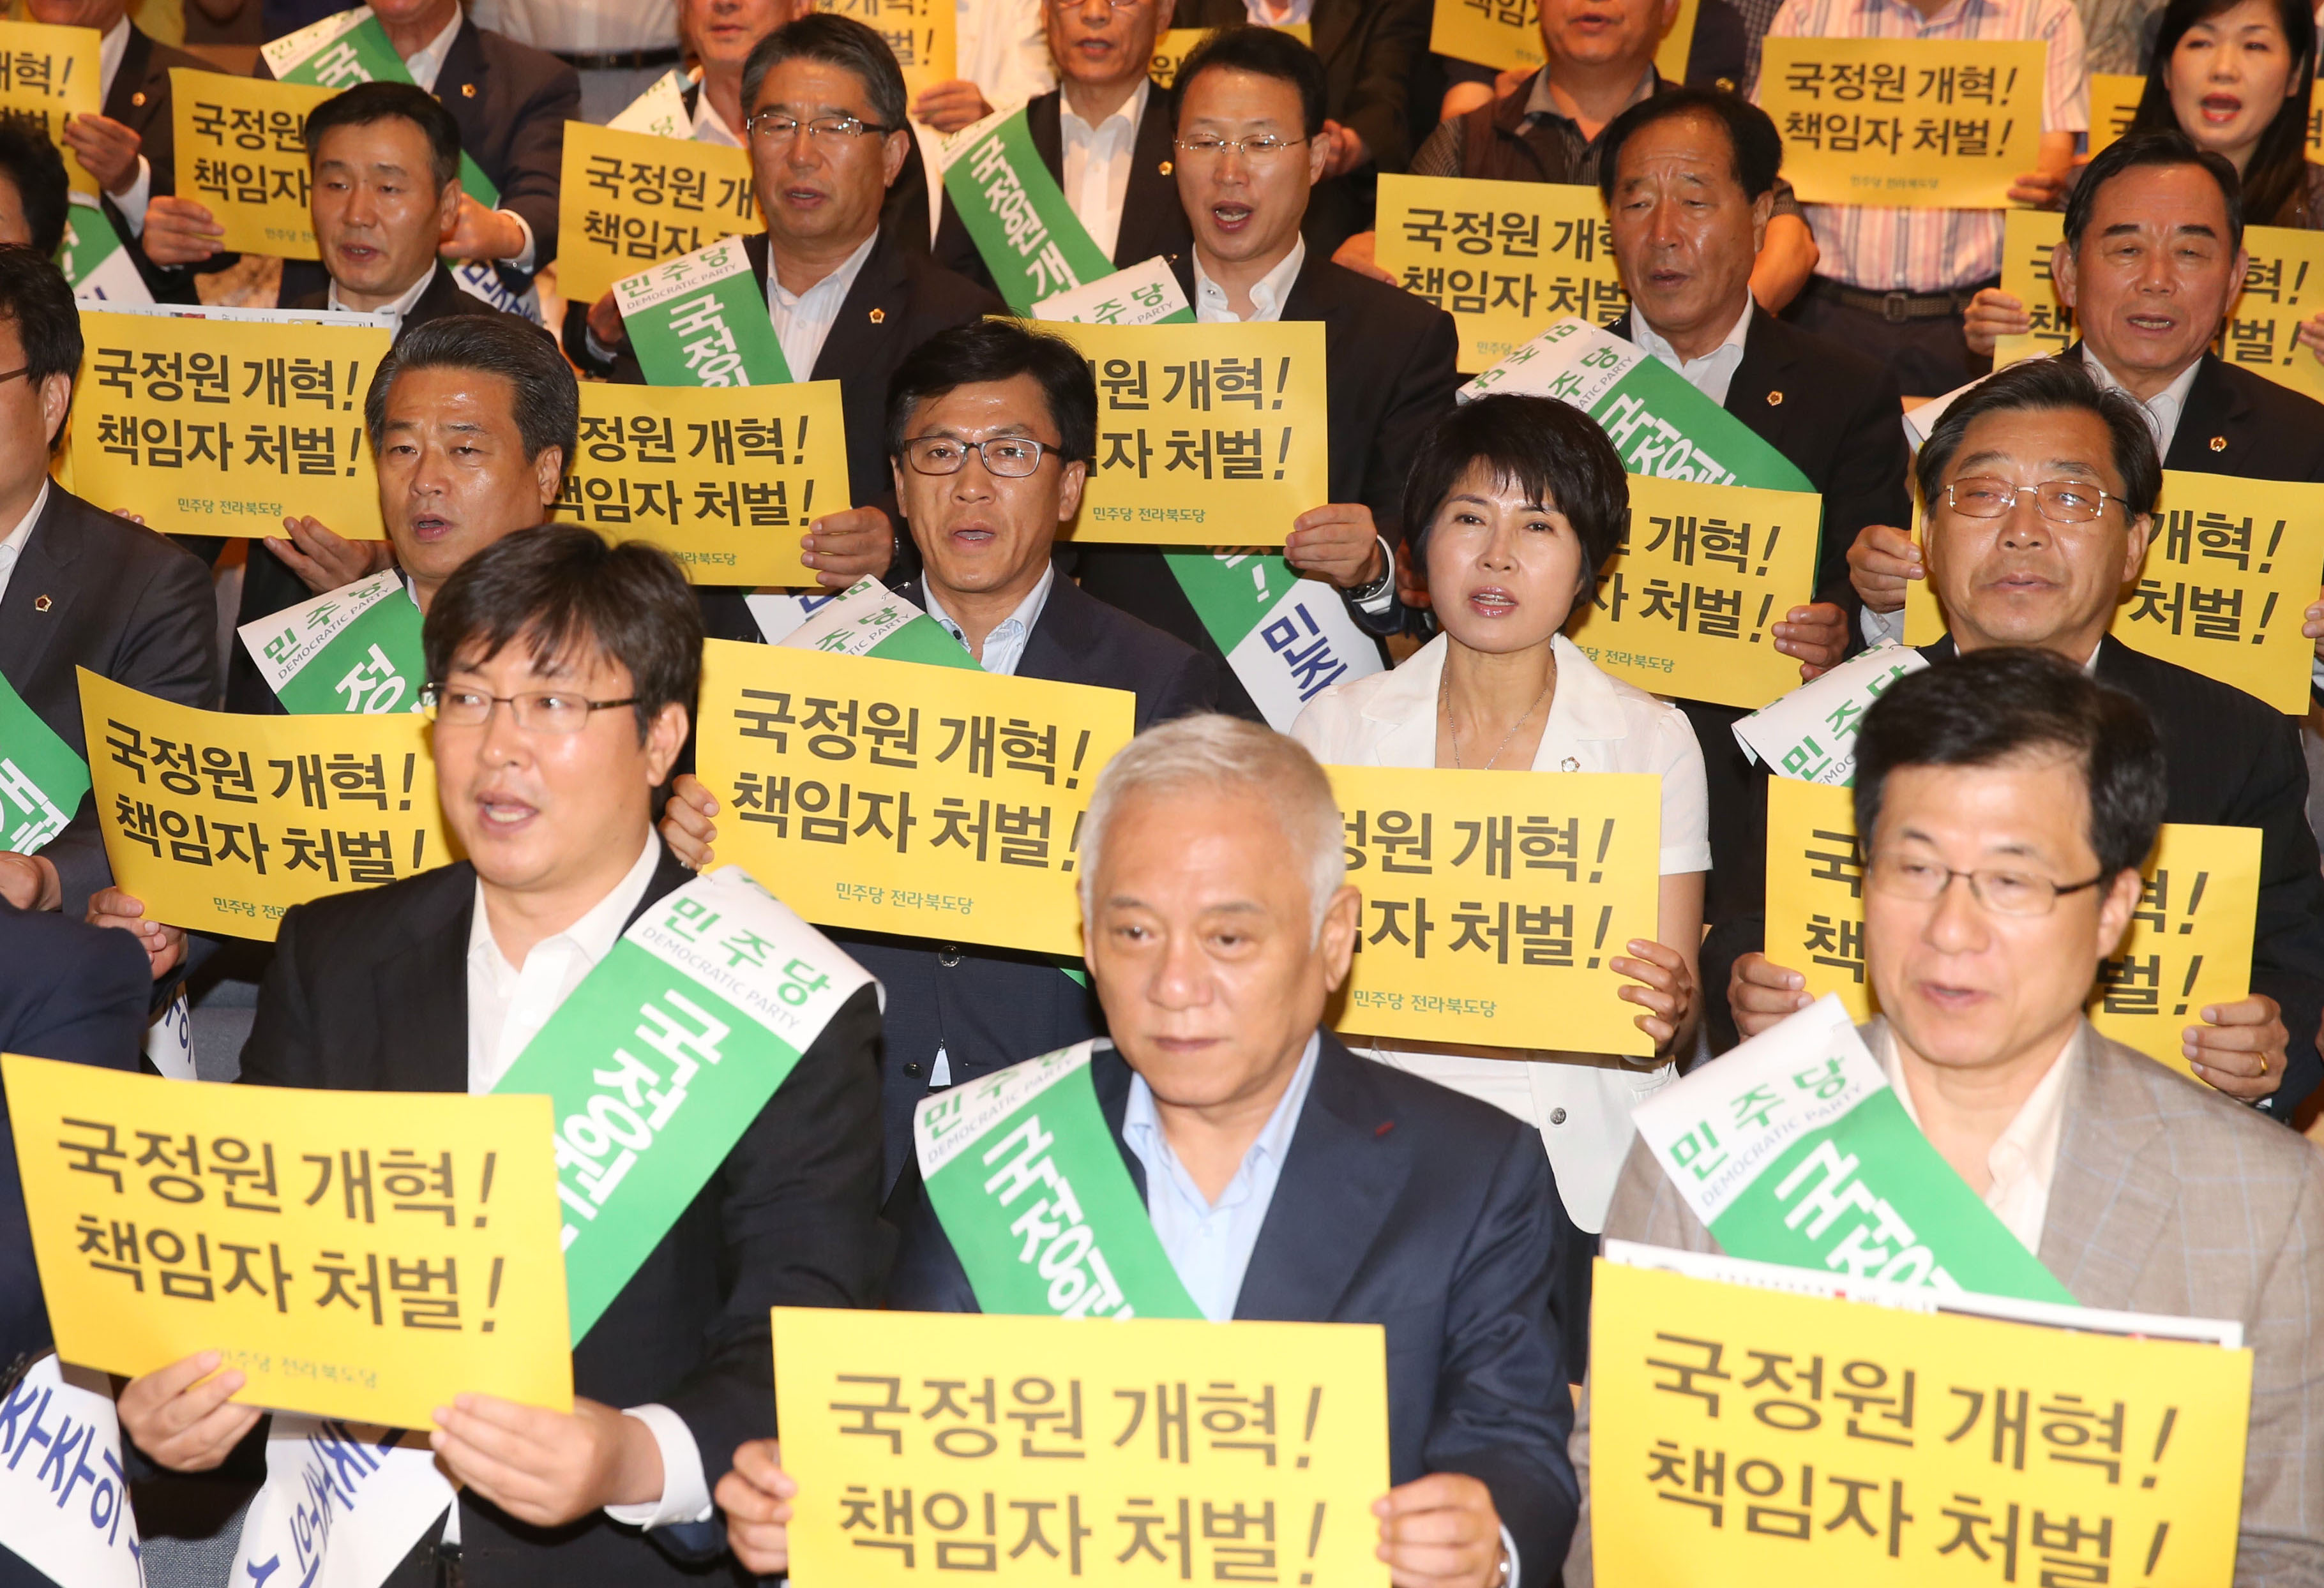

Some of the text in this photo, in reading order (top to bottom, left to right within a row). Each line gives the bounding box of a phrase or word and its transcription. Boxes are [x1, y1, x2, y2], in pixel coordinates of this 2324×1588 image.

[1786, 63, 2018, 106] 국정원 개혁!
[192, 101, 307, 154] 국정원
[1785, 111, 2013, 157] 책임자 처벌!
[193, 158, 312, 209] 책임자
[586, 154, 706, 212] 국정원
[584, 210, 702, 260] 책임자
[1403, 208, 1539, 258] 국정원
[626, 262, 736, 311] DEMOCRATIC PARTY
[1065, 283, 1165, 324] 주당
[1137, 301, 1173, 324] PARTY
[1403, 267, 1537, 318] 책임자
[1600, 356, 1633, 386] PARTY
[2218, 317, 2300, 366] 벌!
[94, 348, 359, 411] 국정원 개혁!
[1163, 357, 1290, 412] 개혁!
[97, 414, 361, 477] 책임자 처벌!
[688, 414, 810, 465] 개혁!
[1164, 426, 1292, 481] 처벌!
[177, 497, 283, 518] 민주당 전라북도당
[693, 479, 815, 528] 처벌!
[1092, 507, 1206, 523] 민주당 전라북도당
[1645, 516, 1783, 577] 개혁!
[2148, 510, 2286, 574] 개혁!
[278, 587, 389, 680] DEMOCRATIC PARTY
[871, 613, 910, 640] PARTY
[1639, 578, 1774, 643] 처벌!
[2129, 579, 2279, 645] 처벌!
[1605, 650, 1675, 673] 전라북도당
[105, 718, 416, 811] 국정원 개혁!
[733, 688, 1092, 790] 국정원 개혁!
[115, 793, 269, 875] 책임자
[281, 827, 425, 883] 처벌!
[730, 771, 1085, 872] 책임자 처벌!
[1450, 815, 1615, 885] 개혁!
[213, 897, 256, 918] 민주당
[835, 880, 974, 915] 민주당 전라북도당
[1448, 901, 1613, 970] 처벌!
[641, 926, 802, 1031] DEMOCRATIC PARTY
[1353, 989, 1497, 1019] 민주당 전라북도당
[927, 1092, 1020, 1164] DEMOCRATIC
[1669, 1056, 1848, 1181] 민주당
[1701, 1083, 1863, 1208] DEMOCRATIC PARTY
[58, 1116, 497, 1229] 국정원 개혁!
[1774, 1138, 1964, 1293] 국정
[76, 1214, 504, 1333] 책임자 처벌!
[829, 1373, 1323, 1469] 국정원 개혁!
[1644, 1331, 2178, 1490] 국정원 개혁!
[839, 1485, 1327, 1586] 책임자 처벌!
[1645, 1439, 2171, 1588] 책임자 처벌!
